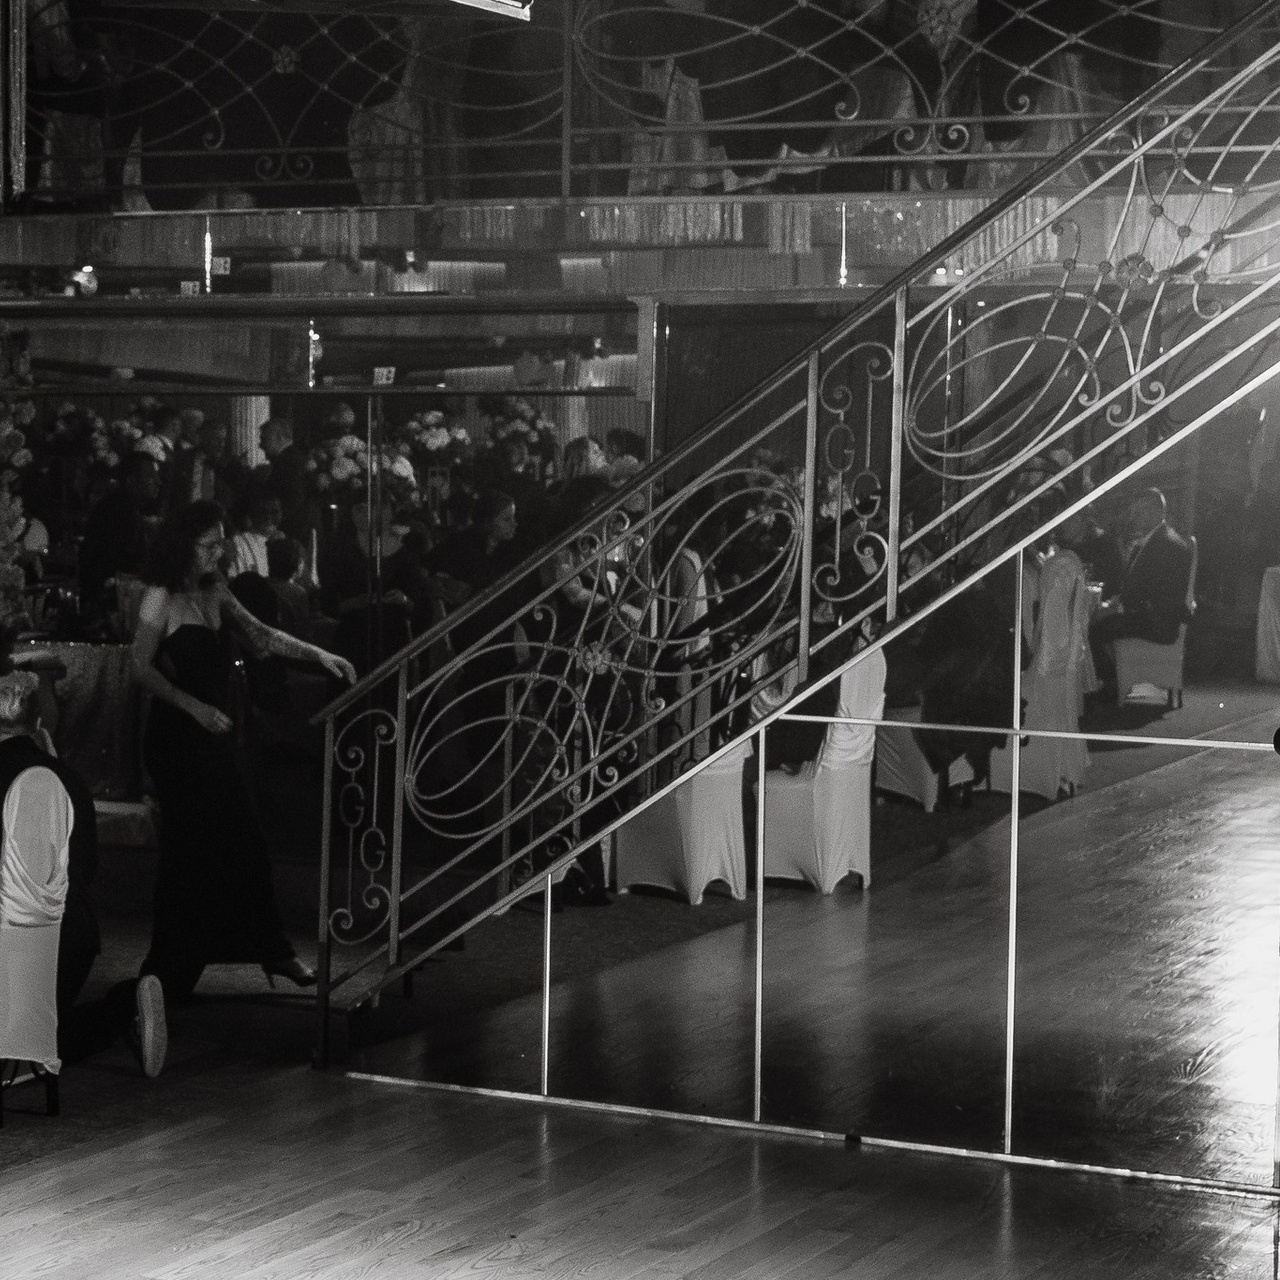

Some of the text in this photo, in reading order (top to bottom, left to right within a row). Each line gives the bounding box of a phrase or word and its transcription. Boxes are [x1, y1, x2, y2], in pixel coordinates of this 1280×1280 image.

[825, 423, 855, 472] G
[851, 471, 881, 520] G
[339, 783, 365, 827] G
[360, 826, 385, 872] G
